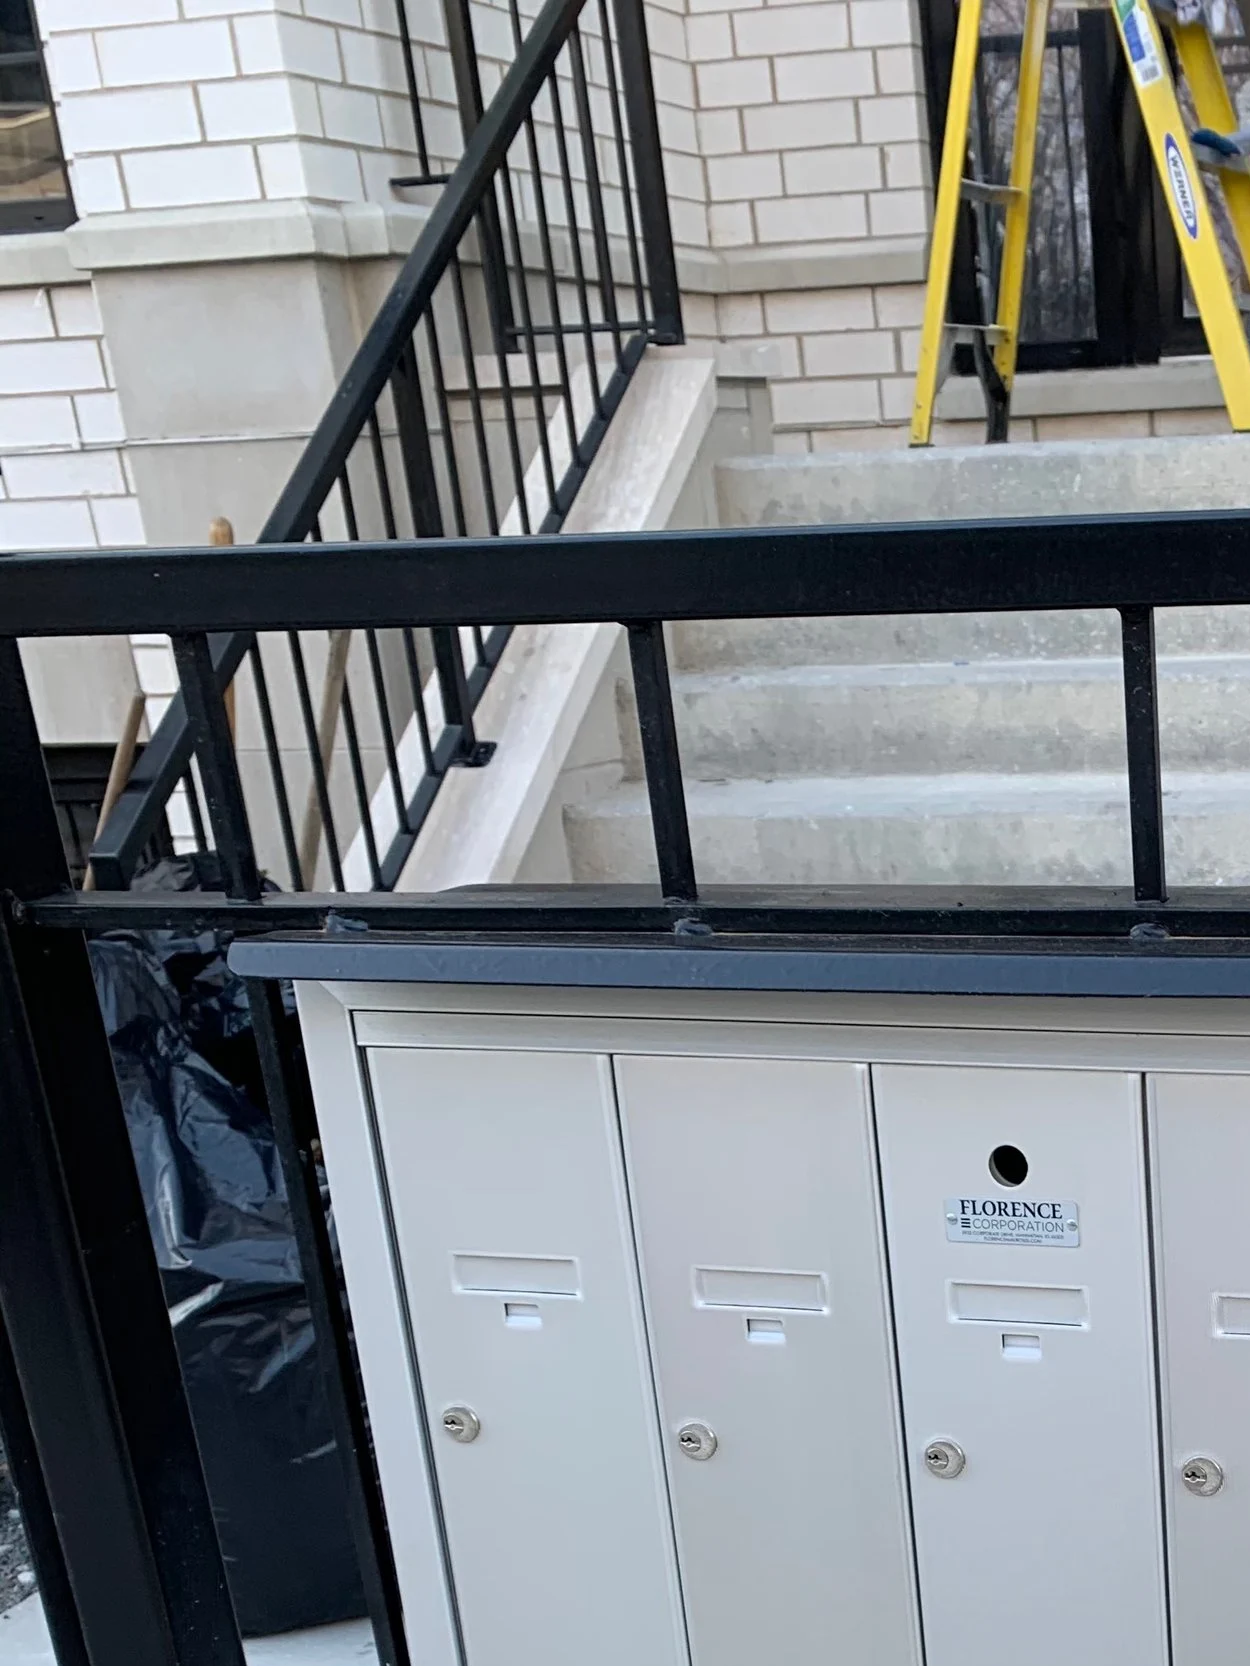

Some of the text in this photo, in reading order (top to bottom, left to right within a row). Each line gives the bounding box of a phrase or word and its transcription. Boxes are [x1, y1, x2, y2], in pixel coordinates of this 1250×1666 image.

[1171, 156, 1193, 219] WERNER
[960, 1199, 1063, 1219] FLORENCE
[972, 1218, 1065, 1233] CORPORATION
